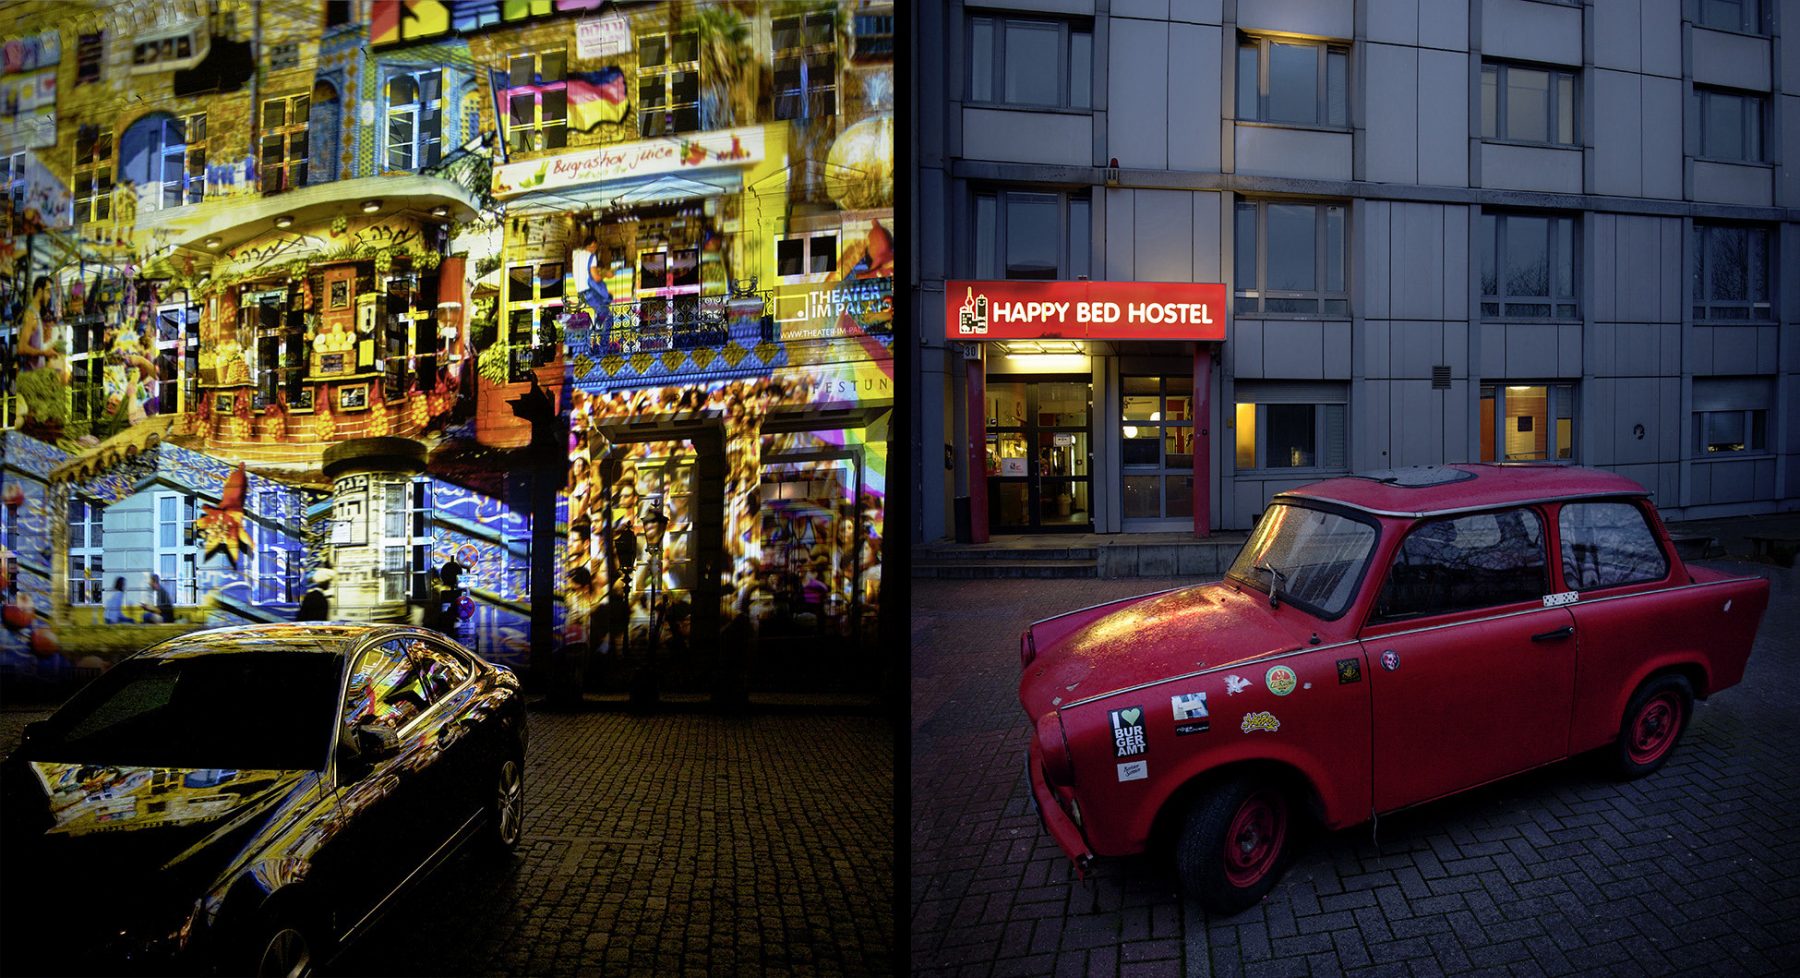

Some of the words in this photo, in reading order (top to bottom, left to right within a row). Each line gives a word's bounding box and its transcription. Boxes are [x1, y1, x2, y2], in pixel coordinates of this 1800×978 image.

[629, 144, 673, 169] juice
[809, 286, 881, 305] THEATER
[812, 304, 832, 318] IM
[836, 299, 892, 316] PALAIS
[993, 302, 1070, 323] HAPPY
[1077, 302, 1121, 323] BED
[1128, 302, 1213, 324] HOSTEL
[965, 346, 976, 357] 30
[1112, 711, 1121, 729] I
[1115, 726, 1144, 739] BUR
[1116, 734, 1145, 748] GER
[1118, 743, 1147, 757] AMT
